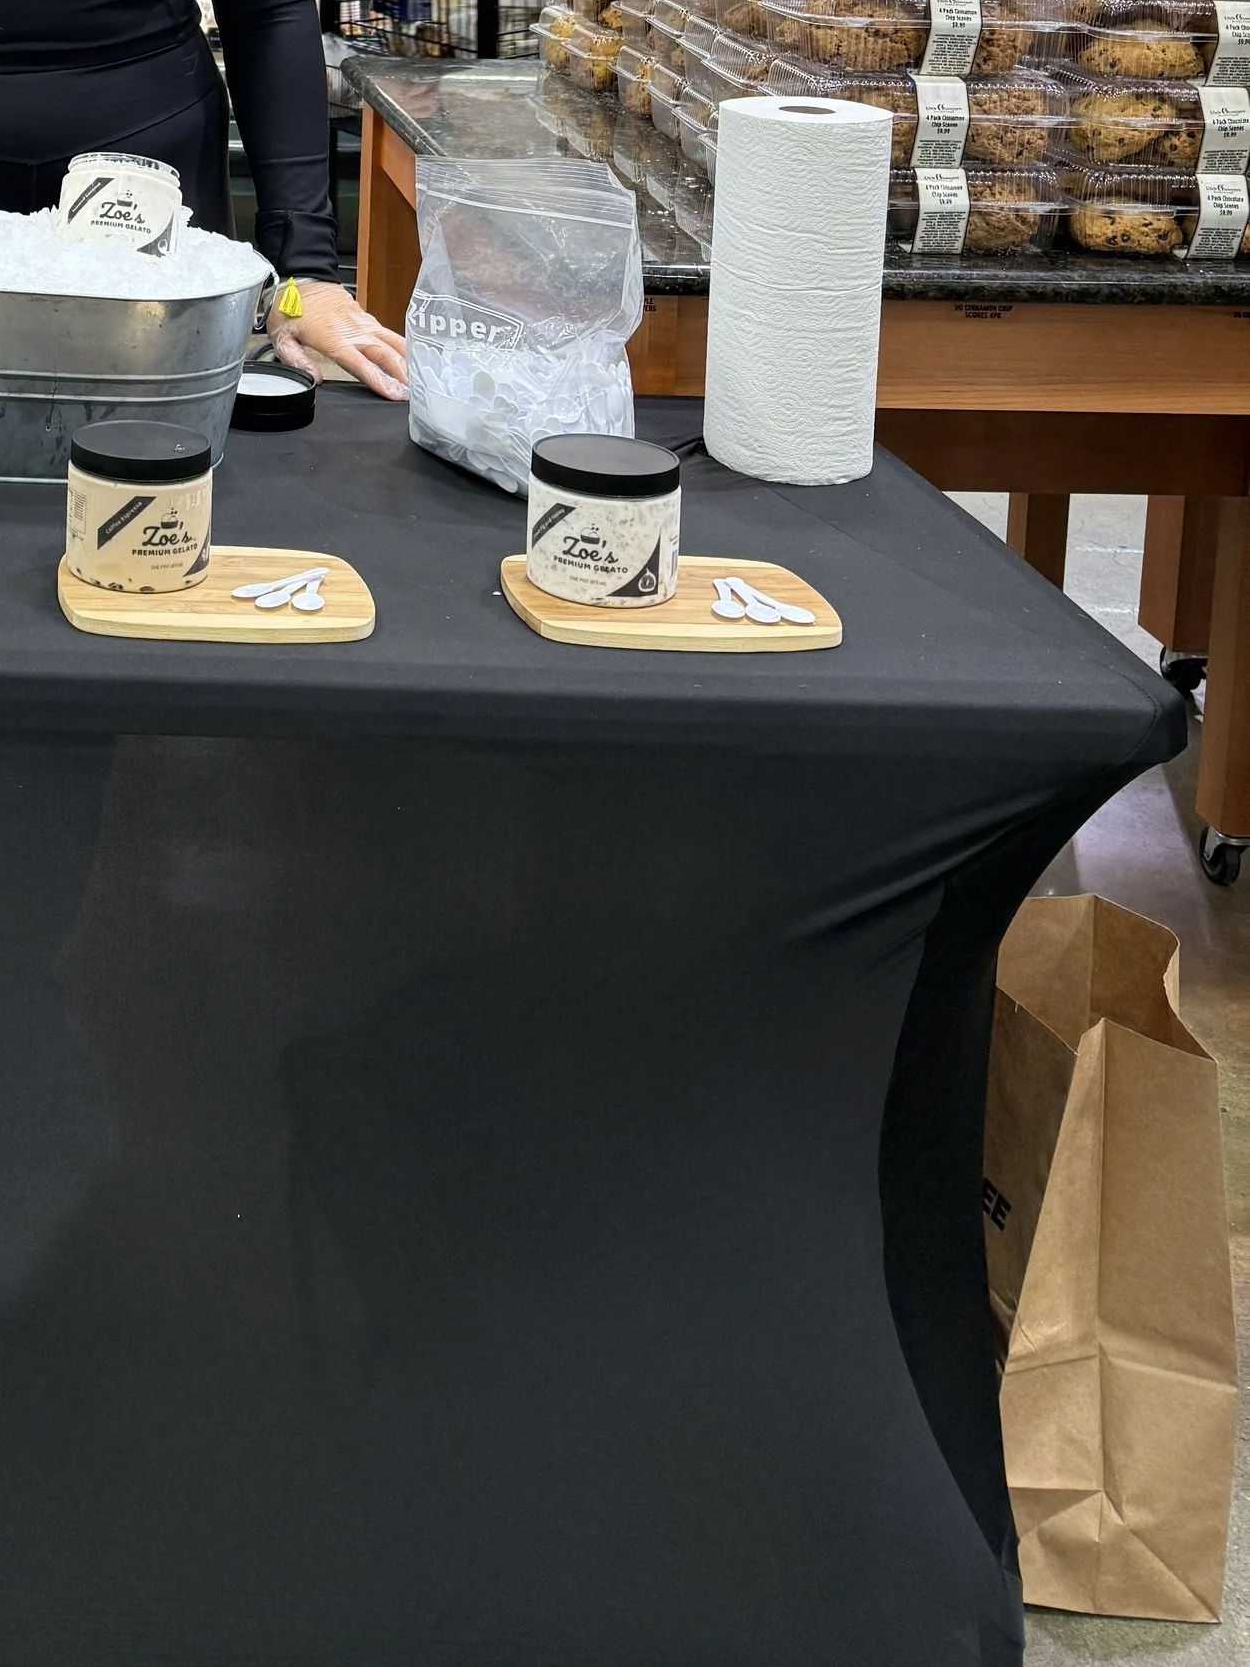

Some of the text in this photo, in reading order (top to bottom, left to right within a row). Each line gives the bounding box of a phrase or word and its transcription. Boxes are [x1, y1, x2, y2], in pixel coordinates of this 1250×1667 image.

[99, 201, 146, 224] Zoe's
[90, 219, 152, 234] PREMIUM GELATO
[142, 521, 193, 547] Zoe's
[131, 543, 198, 557] PREMIUM GELATO
[562, 535, 619, 564] Zoe's
[553, 554, 629, 574] PREMIUM GELATO
